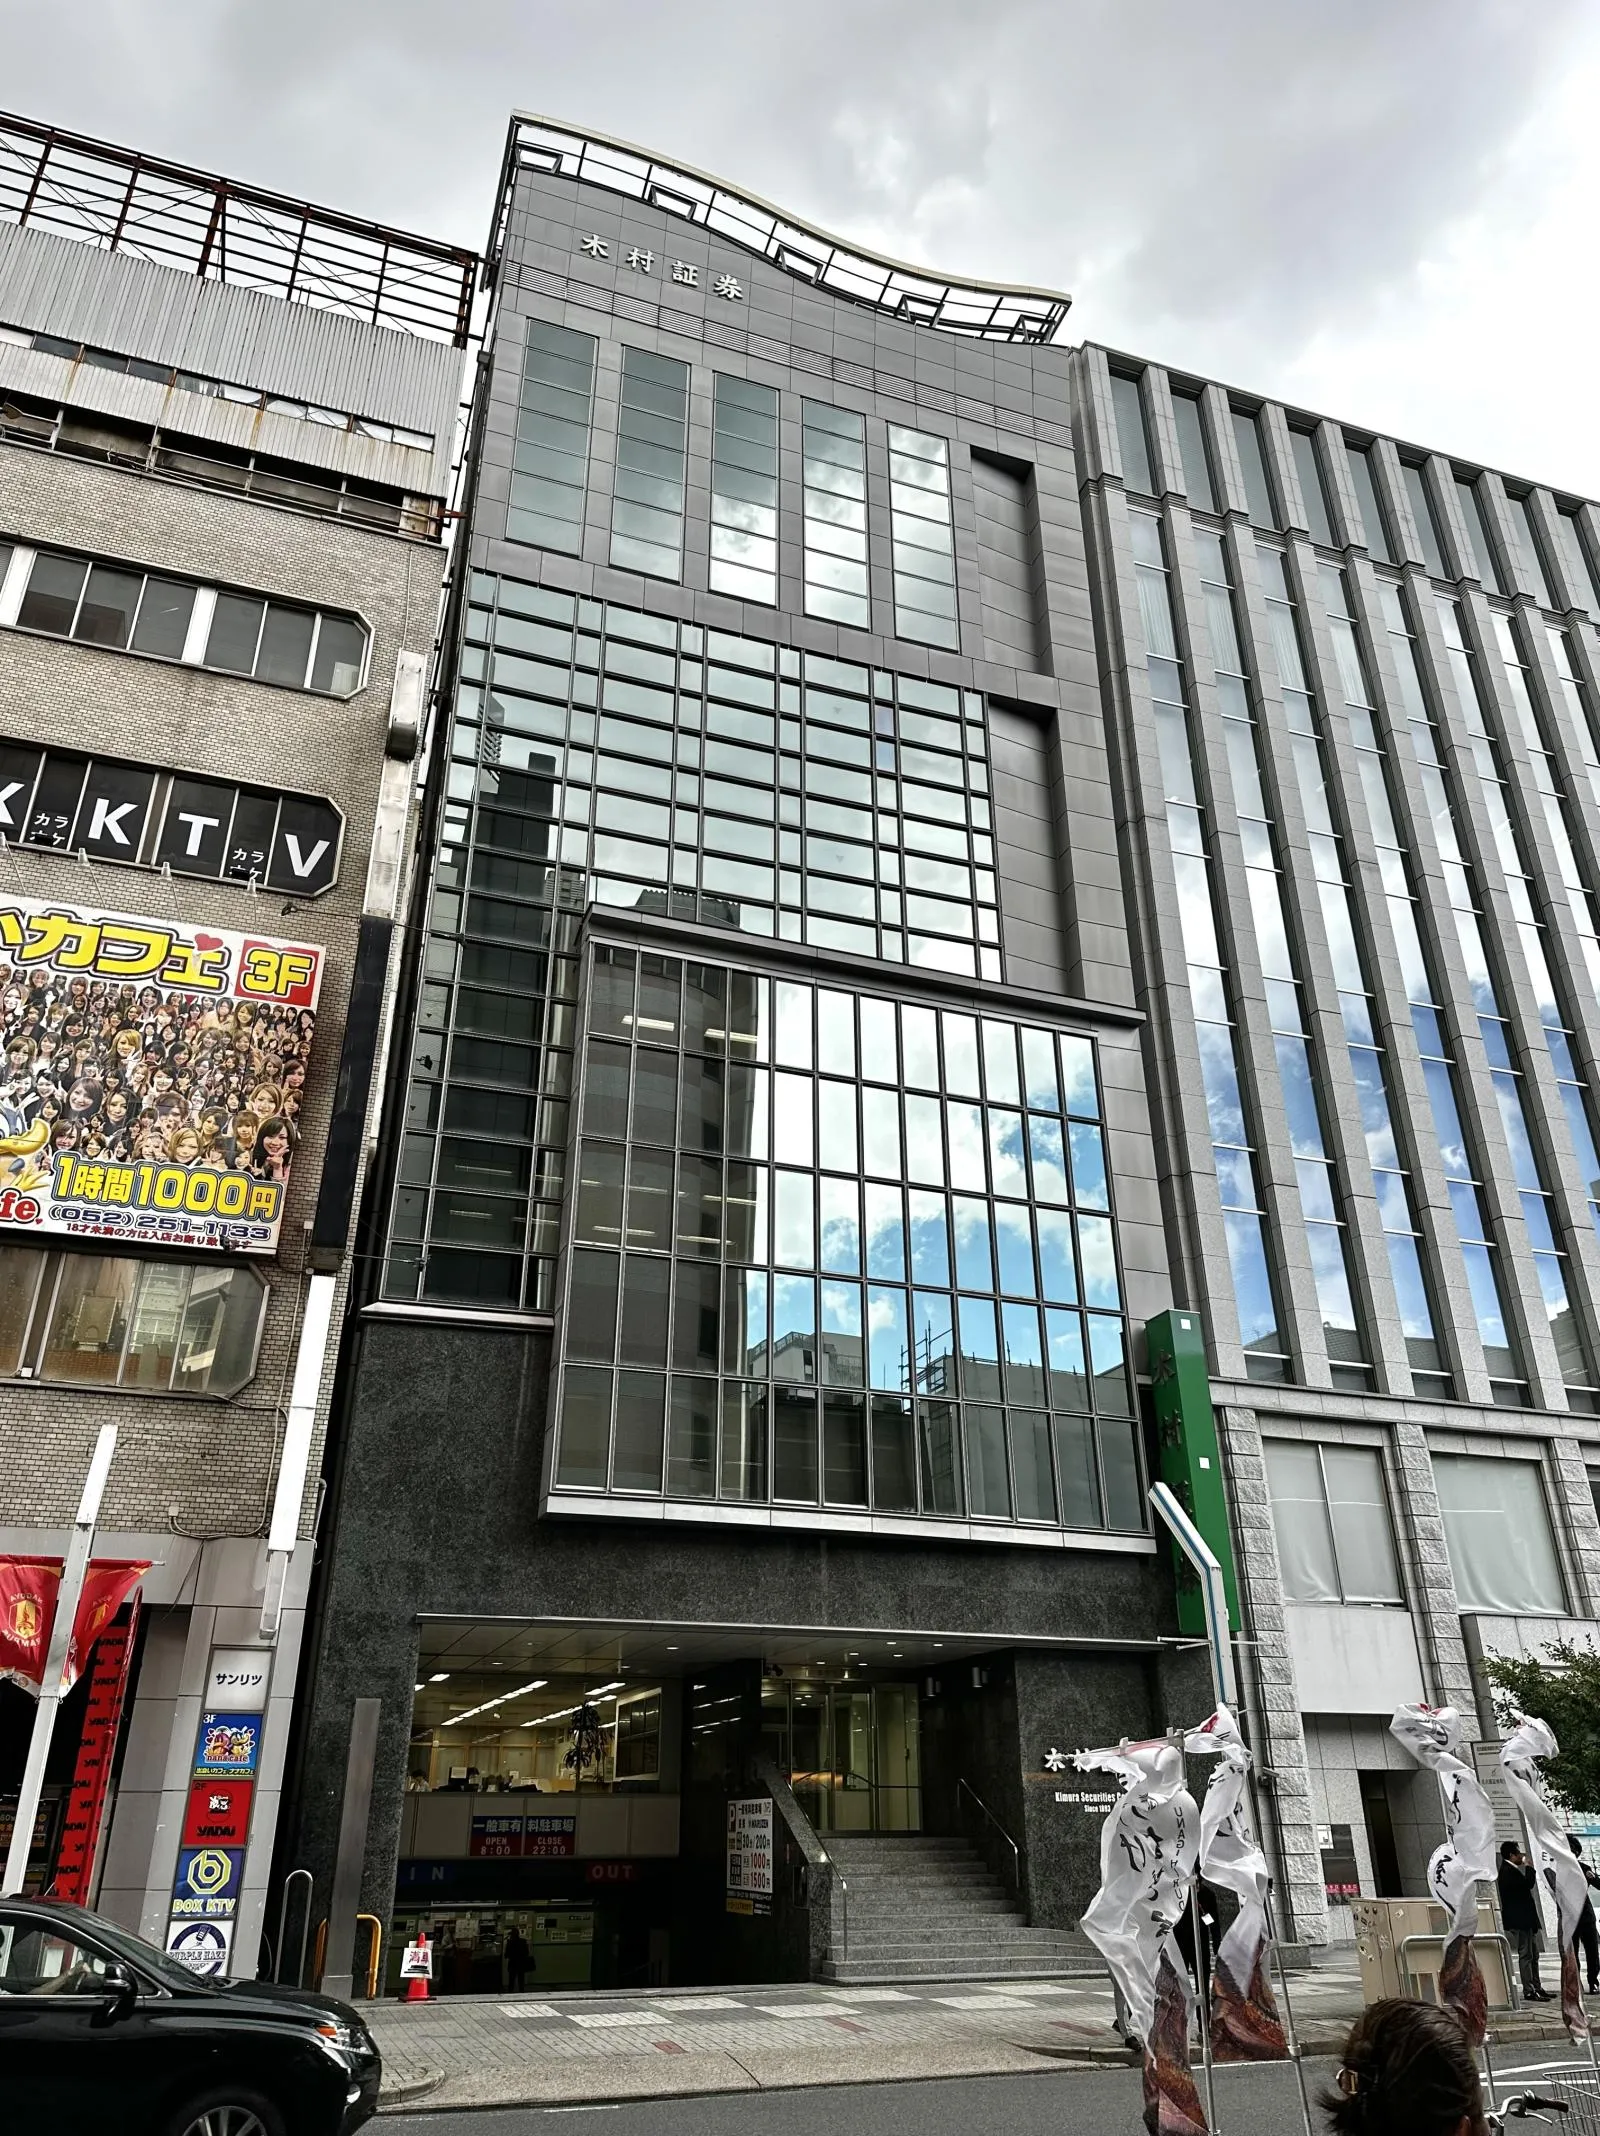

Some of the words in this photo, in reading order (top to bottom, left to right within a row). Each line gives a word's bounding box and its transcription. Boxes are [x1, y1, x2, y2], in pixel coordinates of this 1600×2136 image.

[581, 234, 744, 300] 木村証券
[243, 949, 312, 996] 3F
[56, 1156, 280, 1219] 1時間1000円
[216, 1673, 262, 1685] サンリツ
[203, 1714, 217, 1724] 3F
[1055, 1792, 1080, 1802] Kimura
[1081, 1792, 1116, 1802] Securities
[485, 1837, 508, 1845] OPEN
[537, 1837, 562, 1845] CLOSE
[481, 1846, 511, 1856] 8:00
[532, 1846, 566, 1855] 22:00
[592, 1865, 633, 1879] OUT
[172, 1898, 204, 1913] BOX
[205, 1898, 236, 1913] KTV
